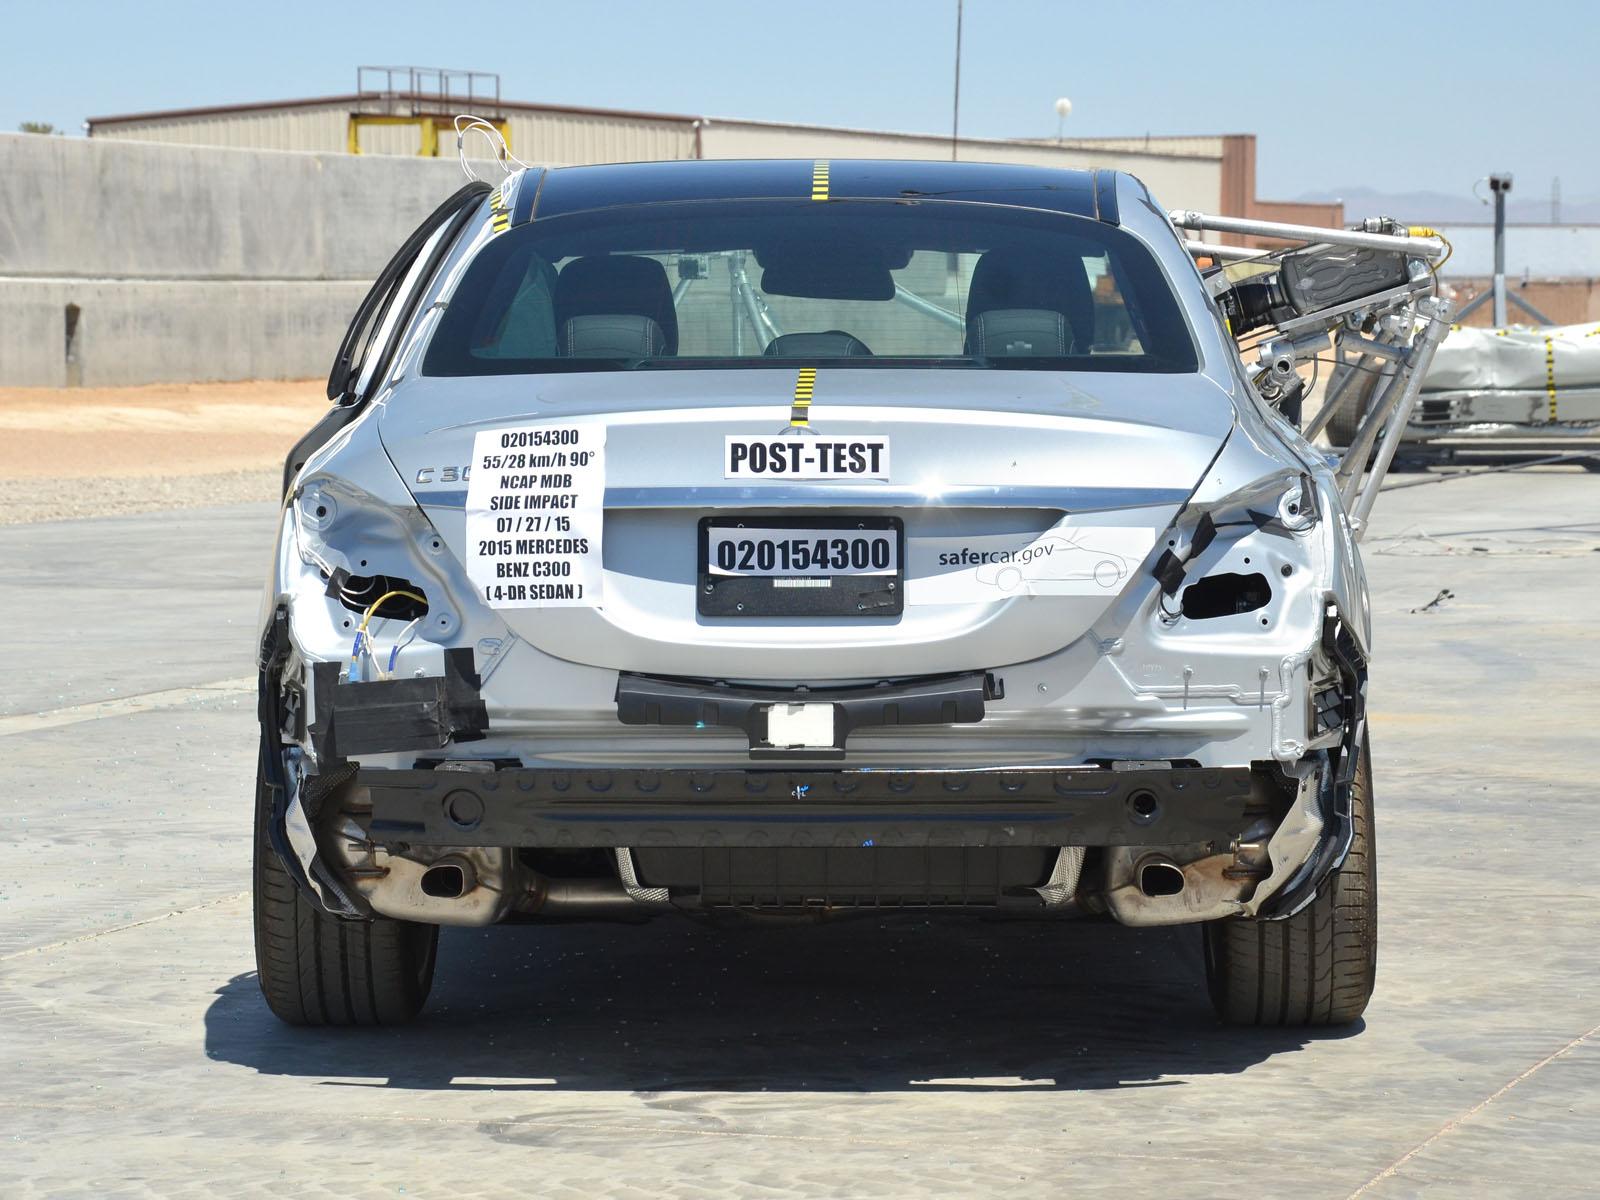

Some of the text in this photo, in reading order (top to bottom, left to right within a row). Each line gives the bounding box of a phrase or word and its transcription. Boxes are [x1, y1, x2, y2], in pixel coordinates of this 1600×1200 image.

[501, 429, 579, 448] 020154300
[483, 454, 525, 469] 55/28
[529, 451, 567, 468] km/h
[730, 442, 884, 473] POST-TEST
[415, 467, 435, 484] C
[500, 474, 572, 489] NCAP MDB
[490, 494, 578, 511] SIDE IMPACT
[496, 517, 512, 533] 07
[525, 517, 541, 532] 27
[554, 516, 571, 532] 15
[478, 538, 589, 556] 2015 MERCEDES
[717, 538, 890, 570] 020154300
[938, 543, 1054, 566] safercar.gov
[496, 561, 571, 578] BENZ C300
[494, 585, 526, 601] 4-DR
[529, 584, 574, 600] SEDAN
